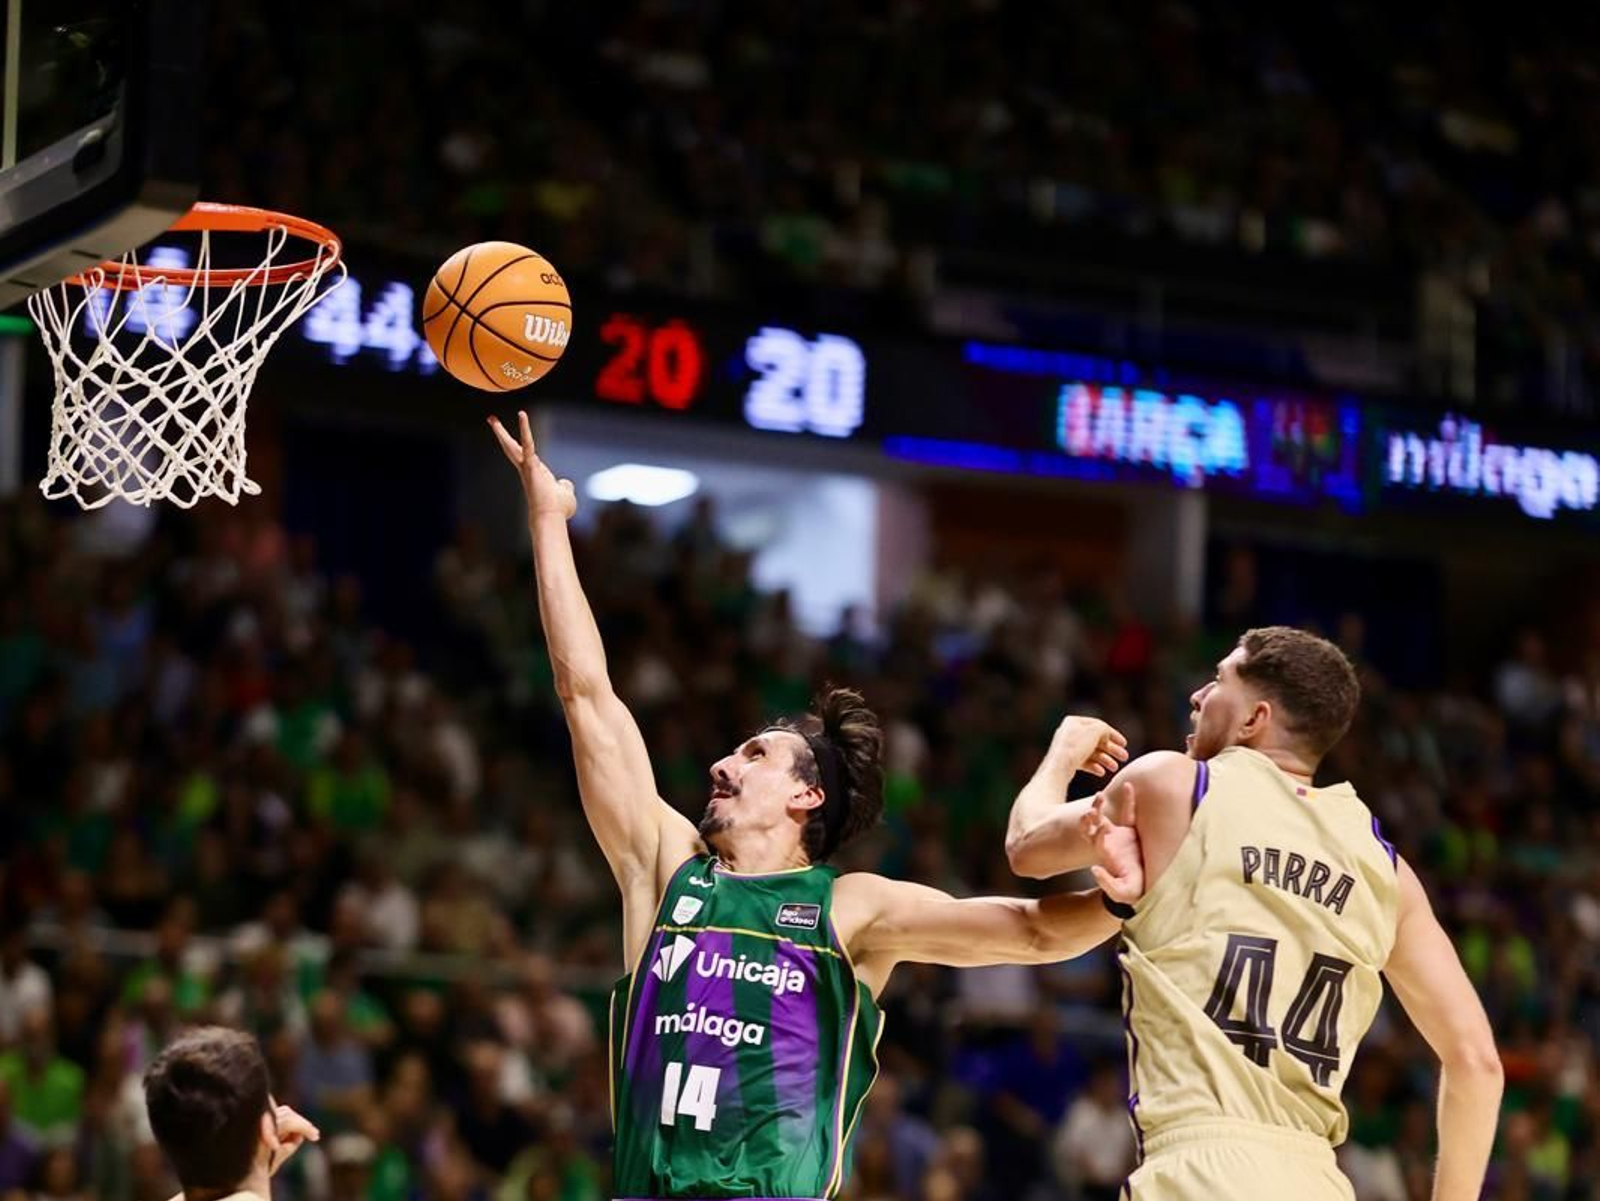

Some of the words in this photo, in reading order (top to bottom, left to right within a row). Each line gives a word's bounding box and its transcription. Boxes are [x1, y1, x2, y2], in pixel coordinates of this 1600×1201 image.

[594, 312, 702, 410] 20
[744, 325, 866, 438] 20
[1240, 846, 1356, 916] PARRA
[695, 950, 806, 996] Unicaja
[654, 1002, 765, 1047] málaga
[1203, 933, 1355, 1088] 44
[660, 1061, 722, 1132] 14
